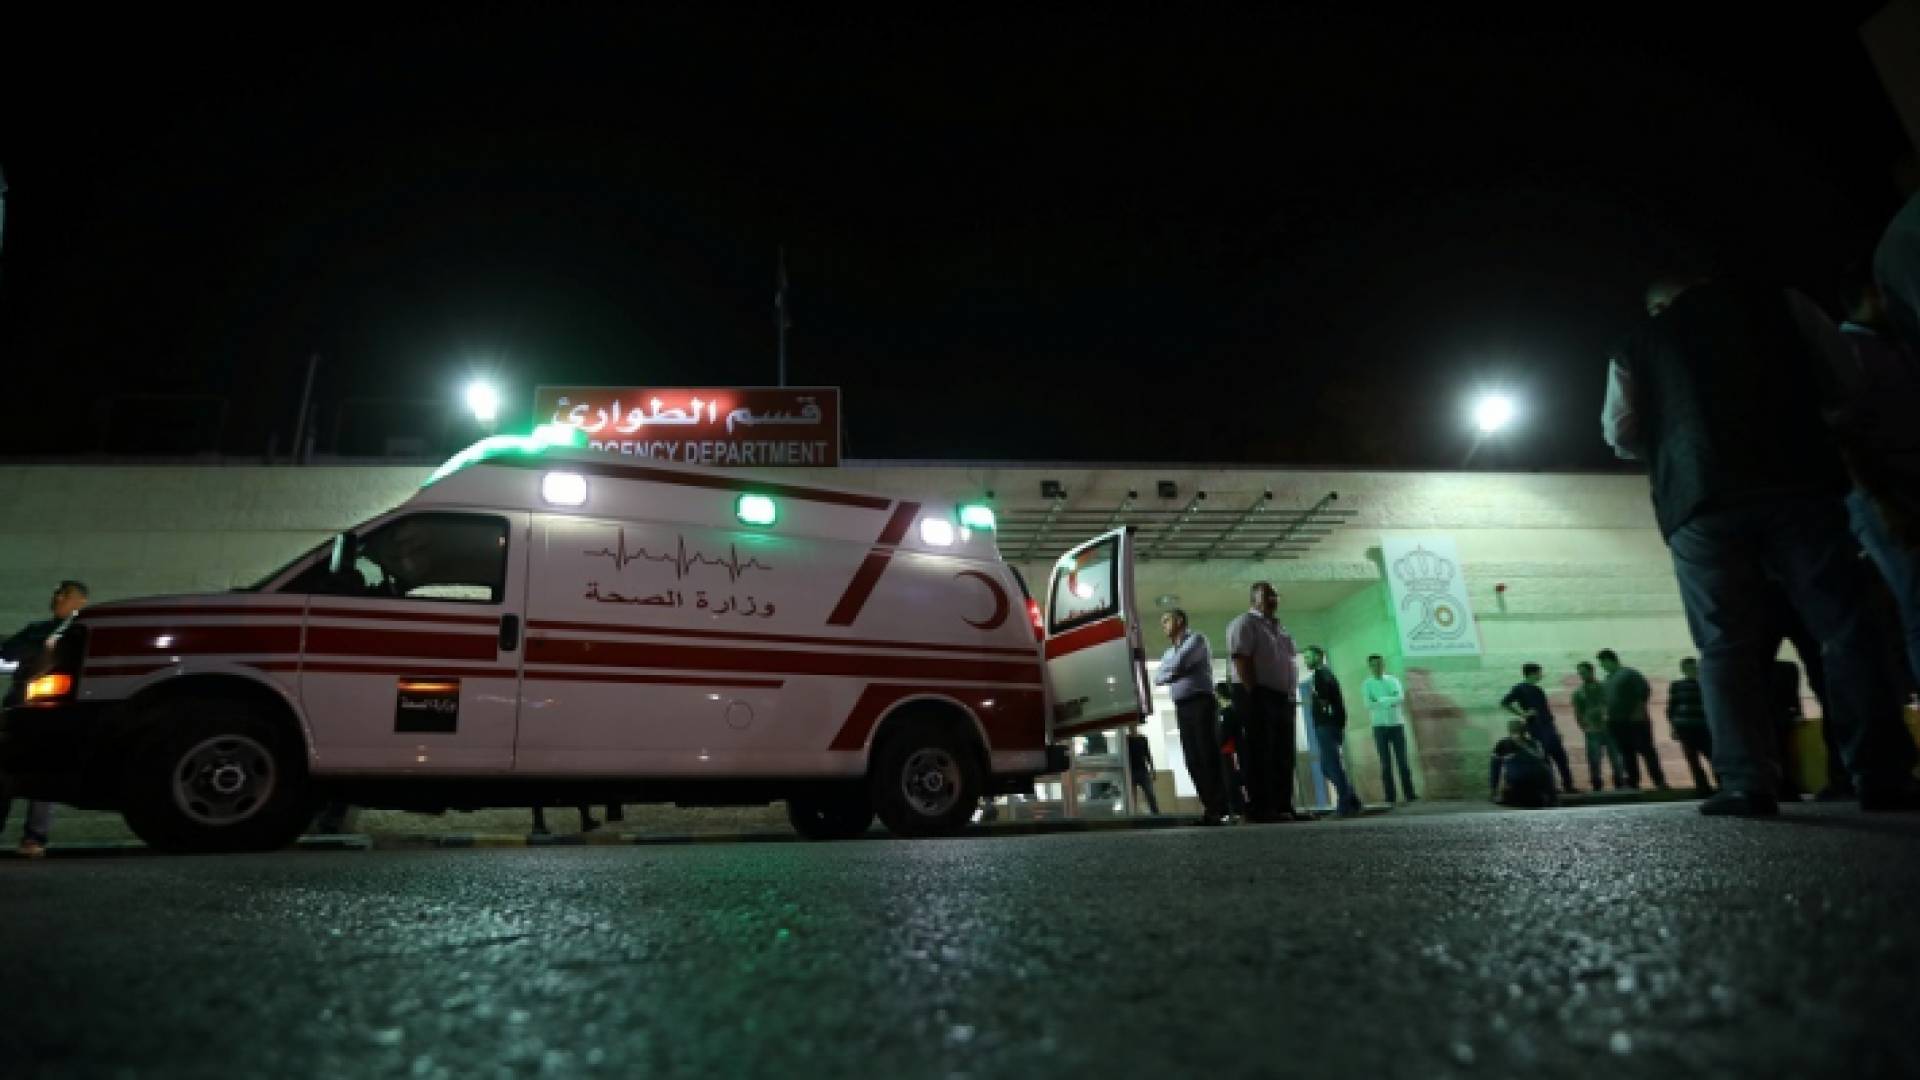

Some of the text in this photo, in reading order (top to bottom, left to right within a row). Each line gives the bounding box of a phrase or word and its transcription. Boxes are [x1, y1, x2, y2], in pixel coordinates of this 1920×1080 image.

[552, 395, 821, 434] قسم الطوارئ
[588, 440, 828, 464] GENCY DEPARTMENT
[585, 581, 775, 617] وزارة الصحة
